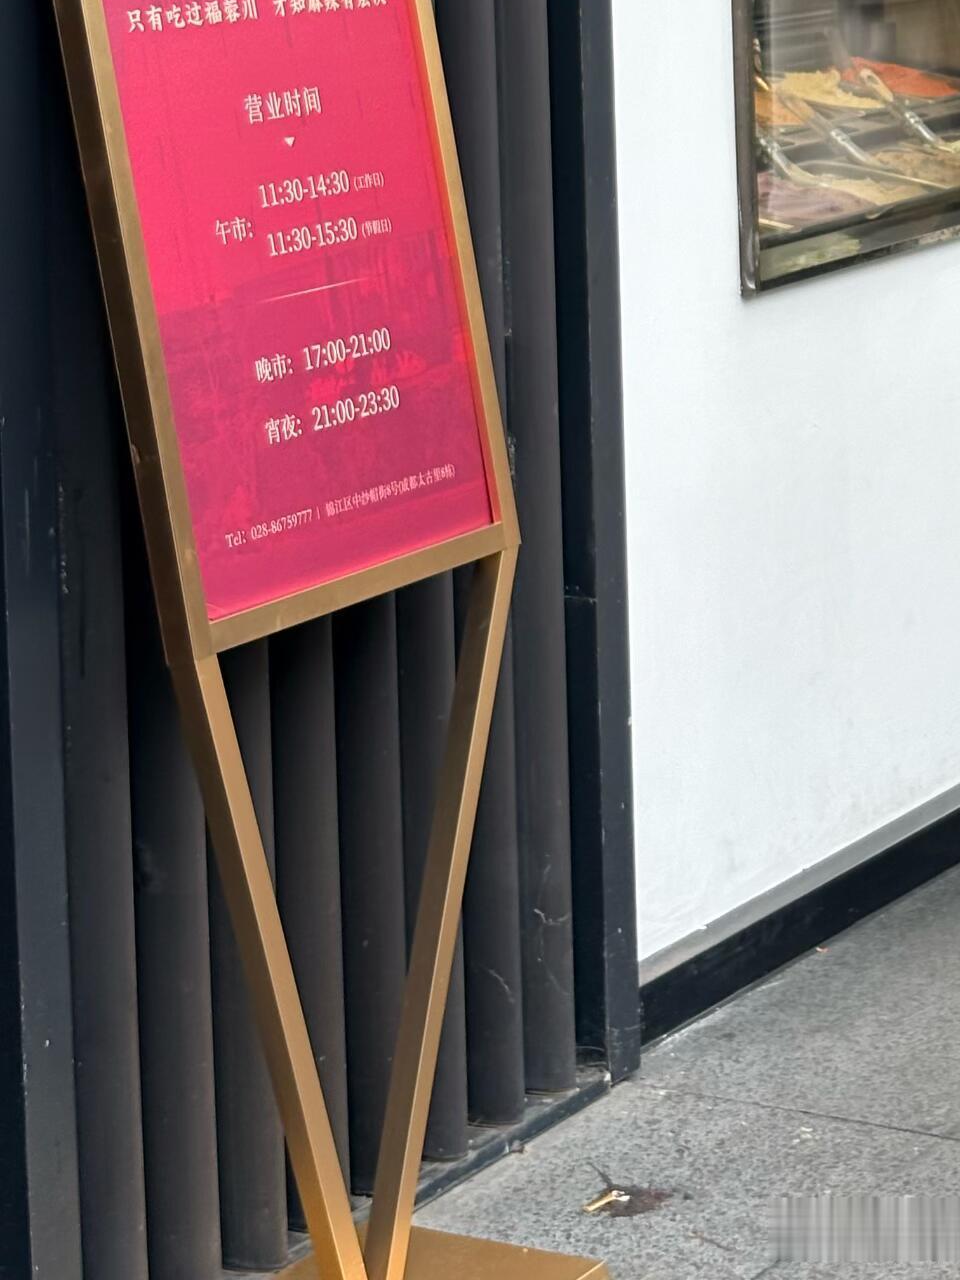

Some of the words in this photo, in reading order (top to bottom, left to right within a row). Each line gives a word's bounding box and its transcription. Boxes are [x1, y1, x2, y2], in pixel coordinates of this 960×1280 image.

[244, 87, 322, 124] 营业时间
[258, 170, 350, 208] 11:30-14:30
[267, 217, 358, 257] 11:30-15:30
[303, 327, 391, 370] 17:00-21:00
[312, 385, 400, 431] 21:00-23:30
[250, 508, 313, 540] 028-86759777
